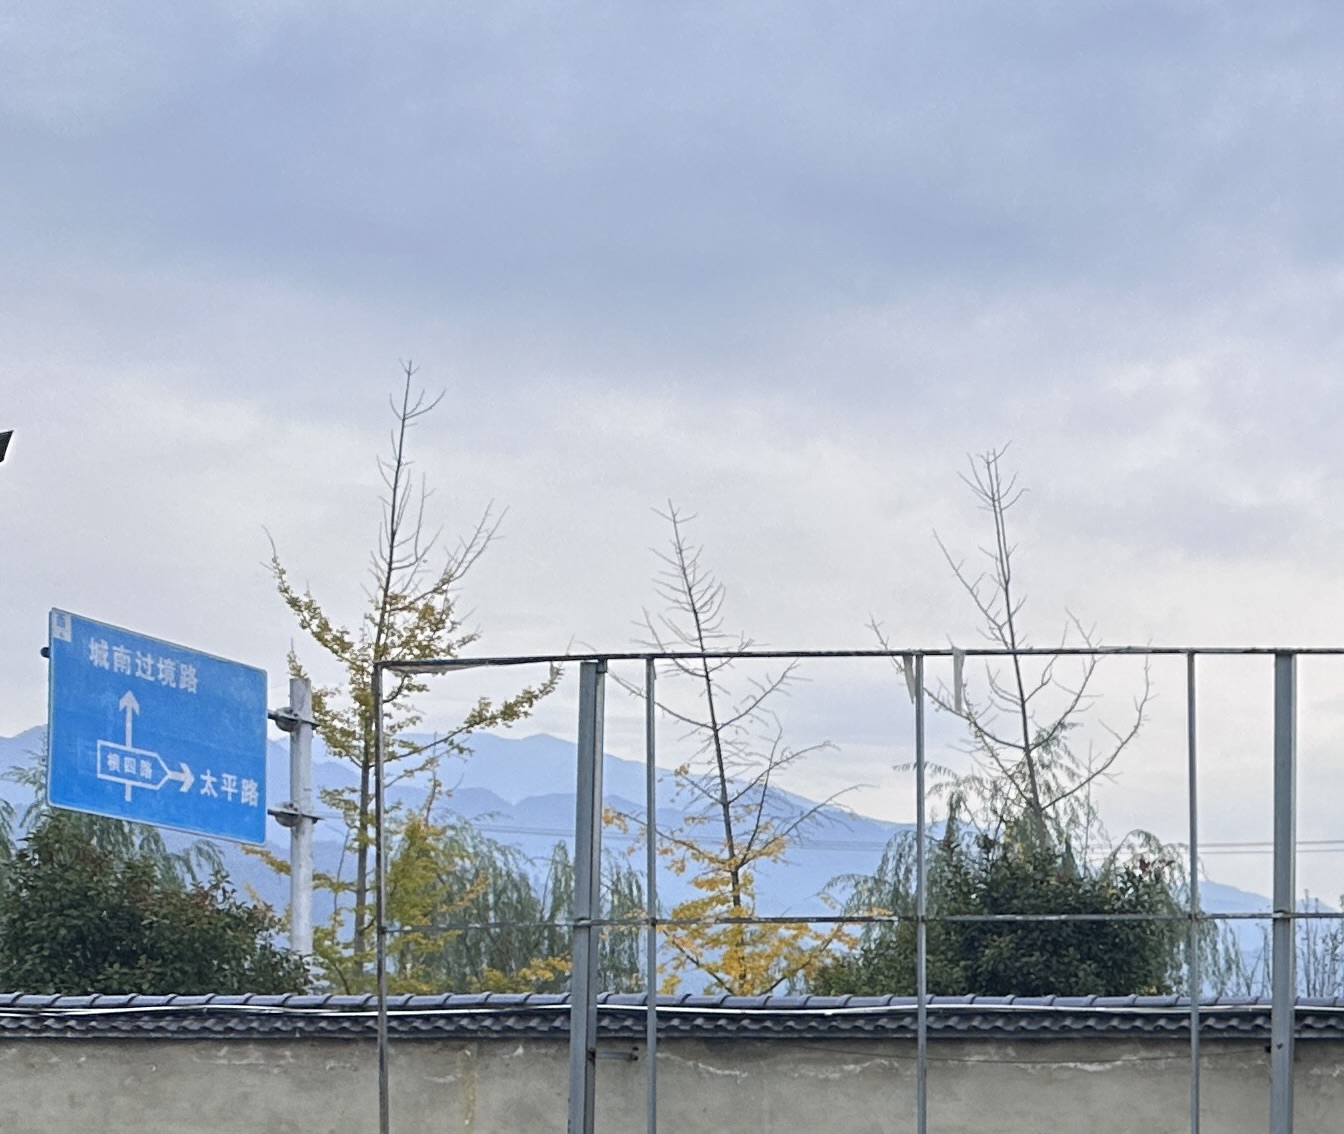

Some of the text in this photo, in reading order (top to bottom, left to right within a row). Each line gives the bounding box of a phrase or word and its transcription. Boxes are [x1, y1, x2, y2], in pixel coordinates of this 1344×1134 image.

[88, 637, 199, 694] 城南过境路
[200, 768, 258, 807] 太平路
